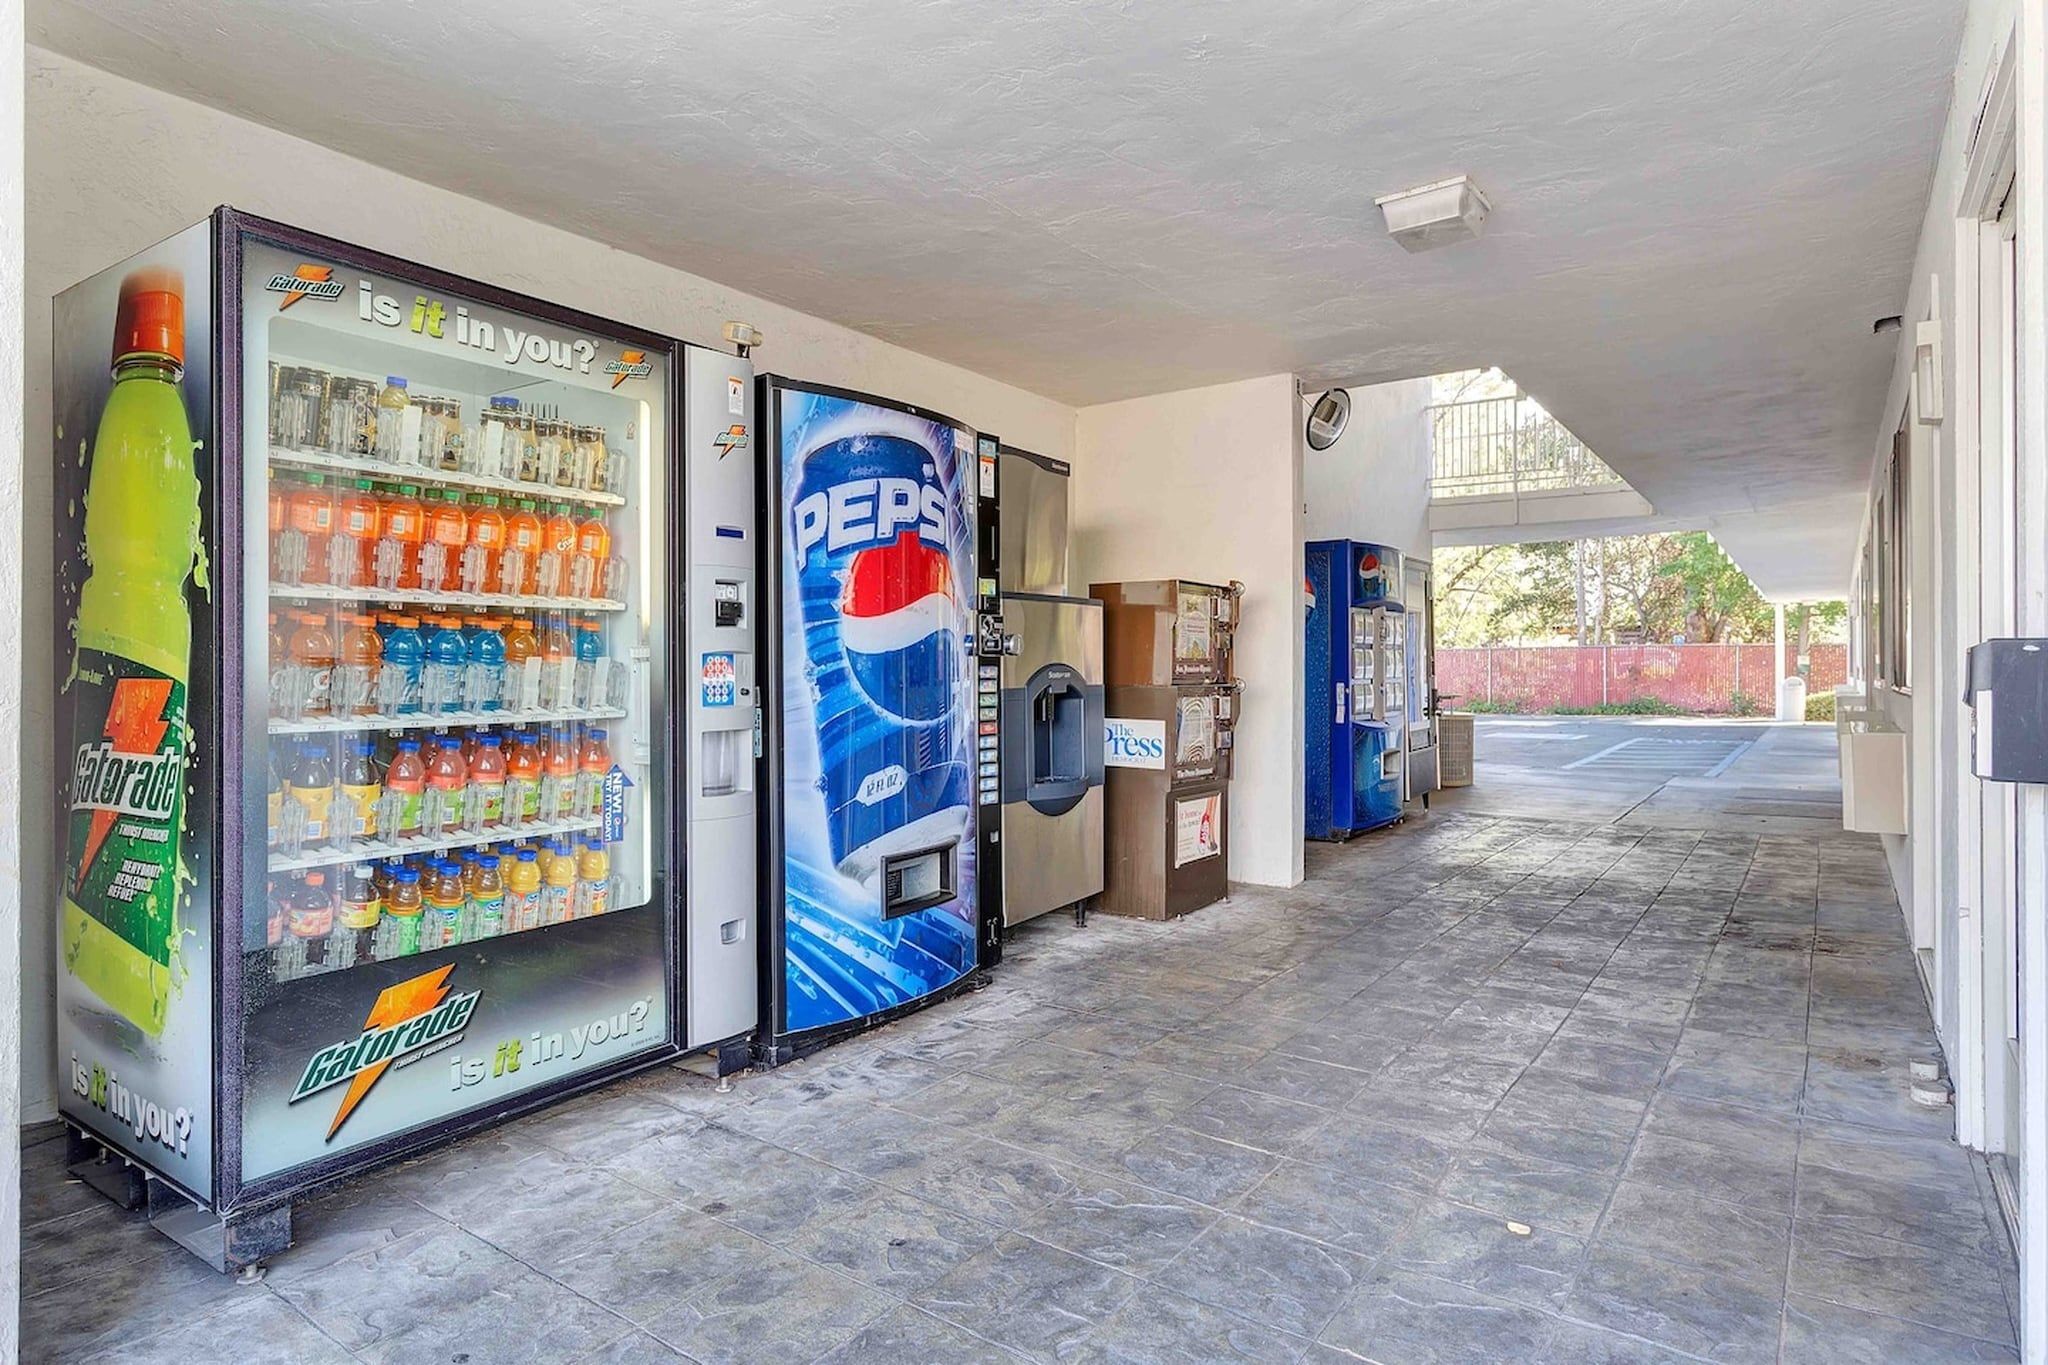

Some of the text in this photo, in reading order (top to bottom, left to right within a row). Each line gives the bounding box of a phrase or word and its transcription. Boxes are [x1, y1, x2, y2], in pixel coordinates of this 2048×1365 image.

[268, 274, 344, 297] Gatorade
[359, 280, 596, 374] is it in you?
[793, 477, 951, 571] PEPS
[1111, 724, 1134, 737] The
[72, 744, 181, 815] Gatorade
[300, 992, 475, 1094] Gatorade
[450, 1000, 649, 1092] is it in you?
[71, 1050, 192, 1159] is it in you?
